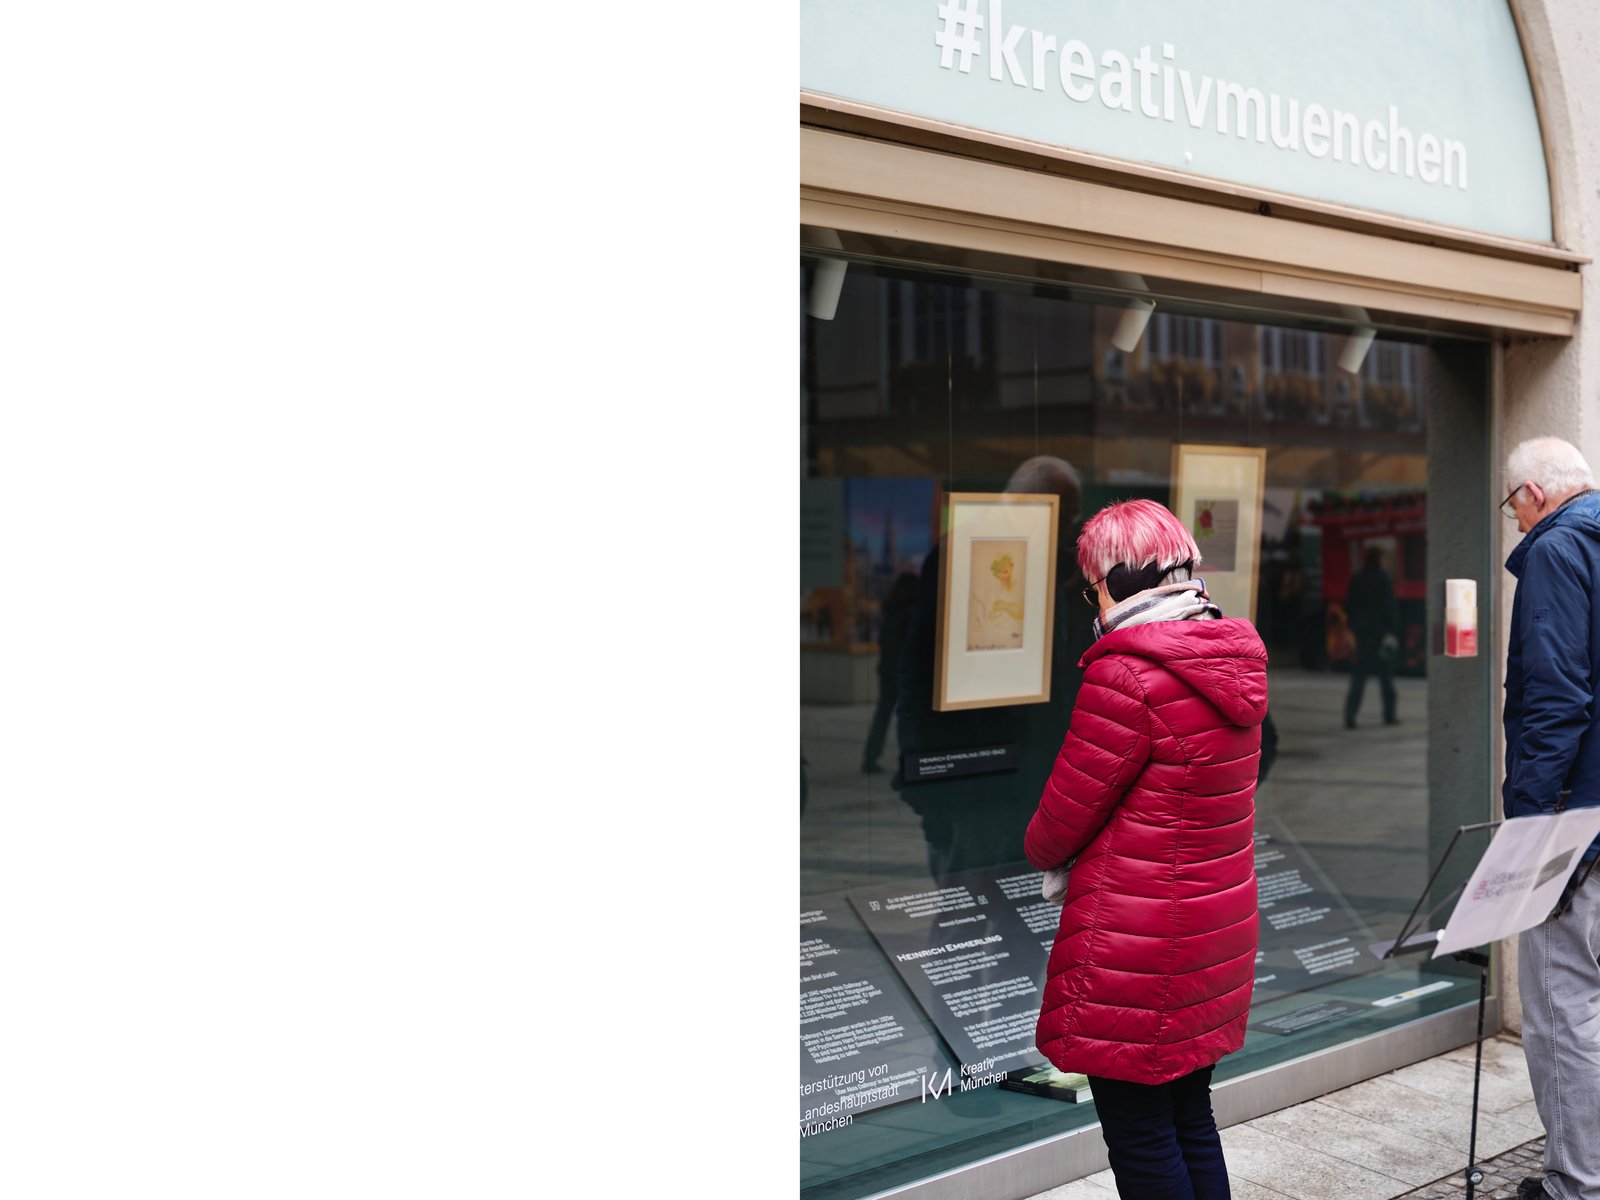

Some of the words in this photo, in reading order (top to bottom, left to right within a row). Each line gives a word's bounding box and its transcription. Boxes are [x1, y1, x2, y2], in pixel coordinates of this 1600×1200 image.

[935, 0, 1468, 190] #kreativmuenchen
[896, 945, 946, 962] HEINRICH
[945, 934, 1002, 952] EMMERLING
[867, 1063, 889, 1078] von
[960, 1057, 995, 1077] Kreativ
[960, 1070, 1008, 1093] München
[800, 1114, 853, 1138] München
